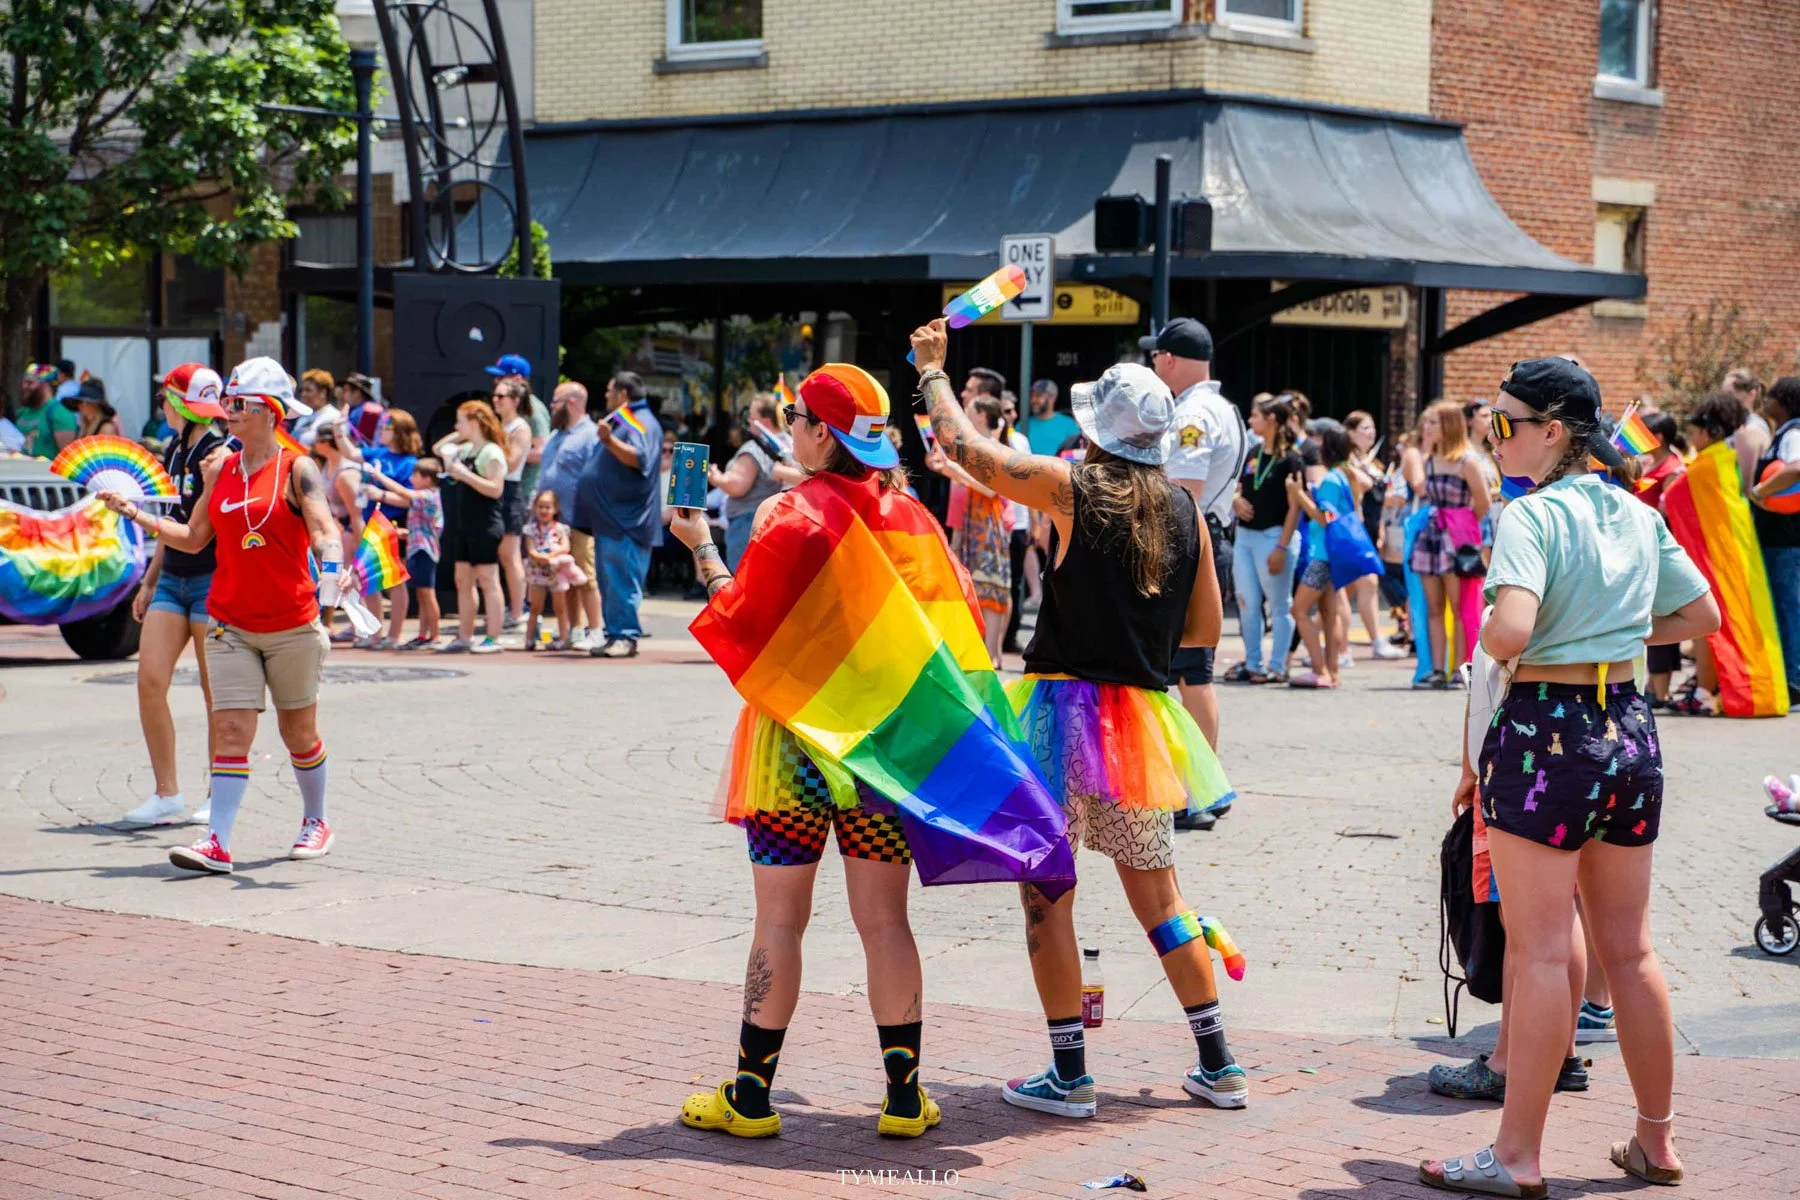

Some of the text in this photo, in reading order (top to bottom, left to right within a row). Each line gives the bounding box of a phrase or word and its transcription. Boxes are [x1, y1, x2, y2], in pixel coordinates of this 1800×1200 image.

[1008, 243, 1044, 263] ONE
[1024, 266, 1046, 284] AY
[1093, 302, 1123, 317] grill
[1056, 352, 1079, 367] 201
[1050, 1033, 1075, 1043] ADDY
